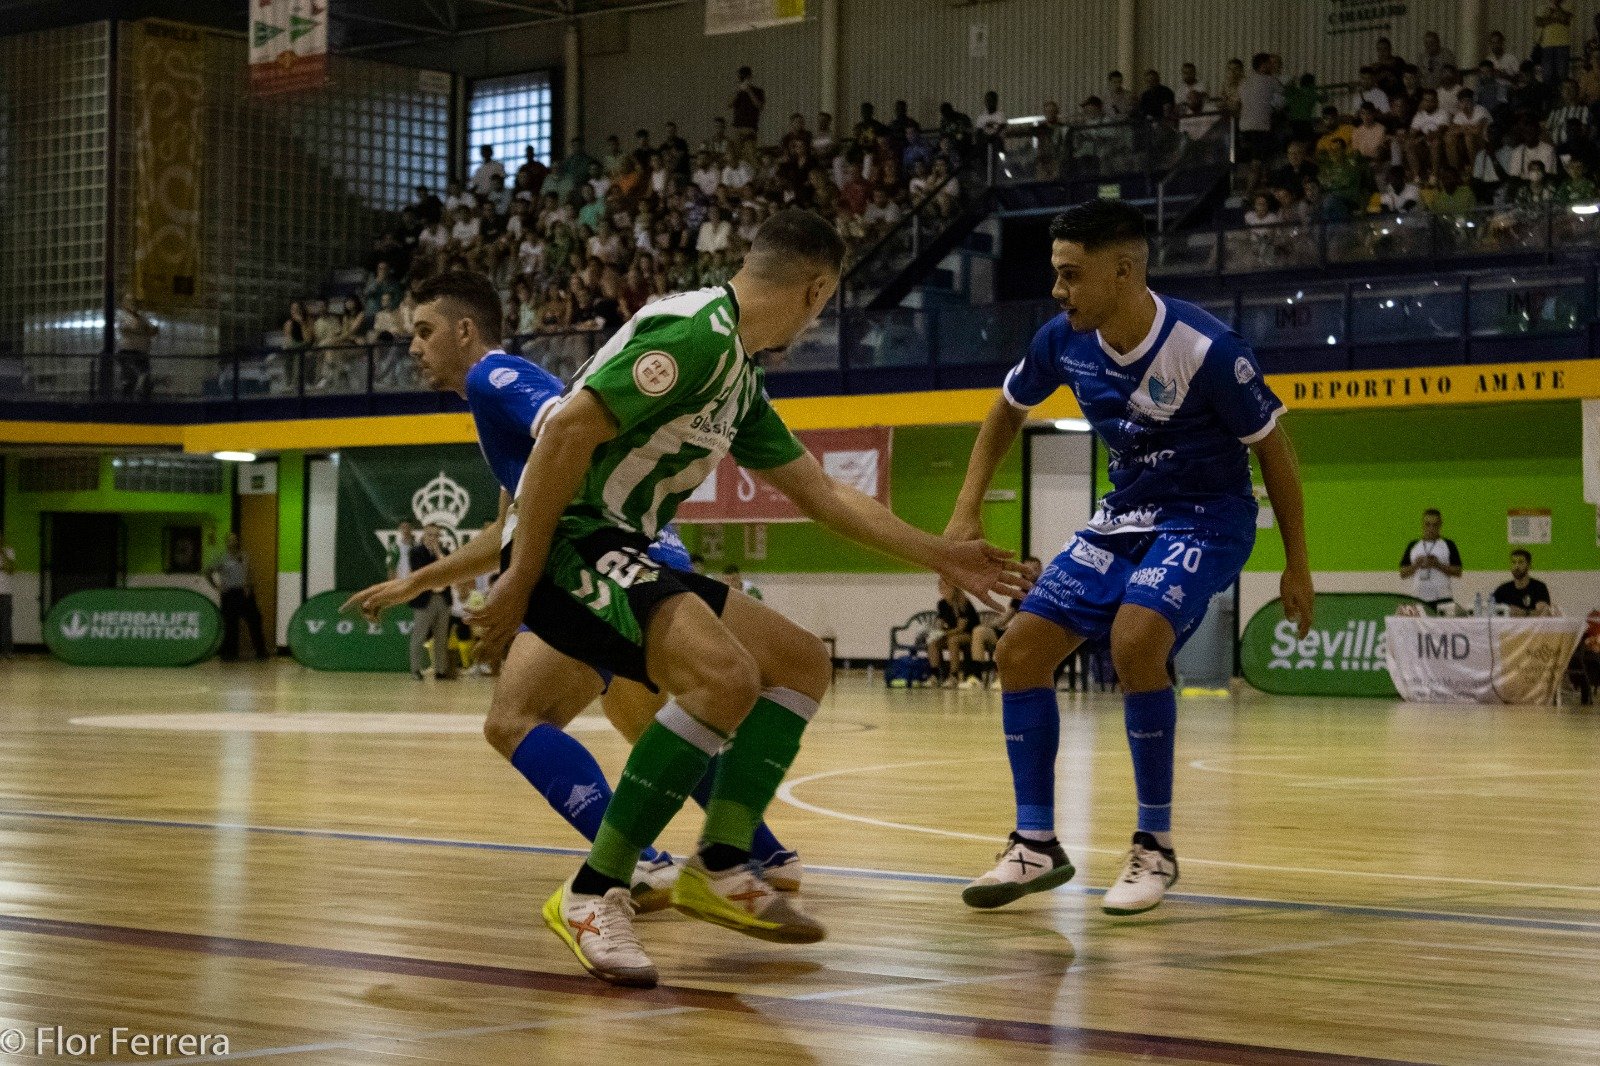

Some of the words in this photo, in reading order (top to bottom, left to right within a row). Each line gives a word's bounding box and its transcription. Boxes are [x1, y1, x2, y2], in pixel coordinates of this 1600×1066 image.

[1294, 376, 1451, 400] DEPORTIVO
[1474, 369, 1566, 393] AMATE
[1161, 541, 1203, 574] 20
[91, 611, 200, 628] HERBALIFE
[304, 620, 415, 635] VOLV
[90, 626, 200, 640] NUTRITION
[1417, 632, 1471, 661] IMD
